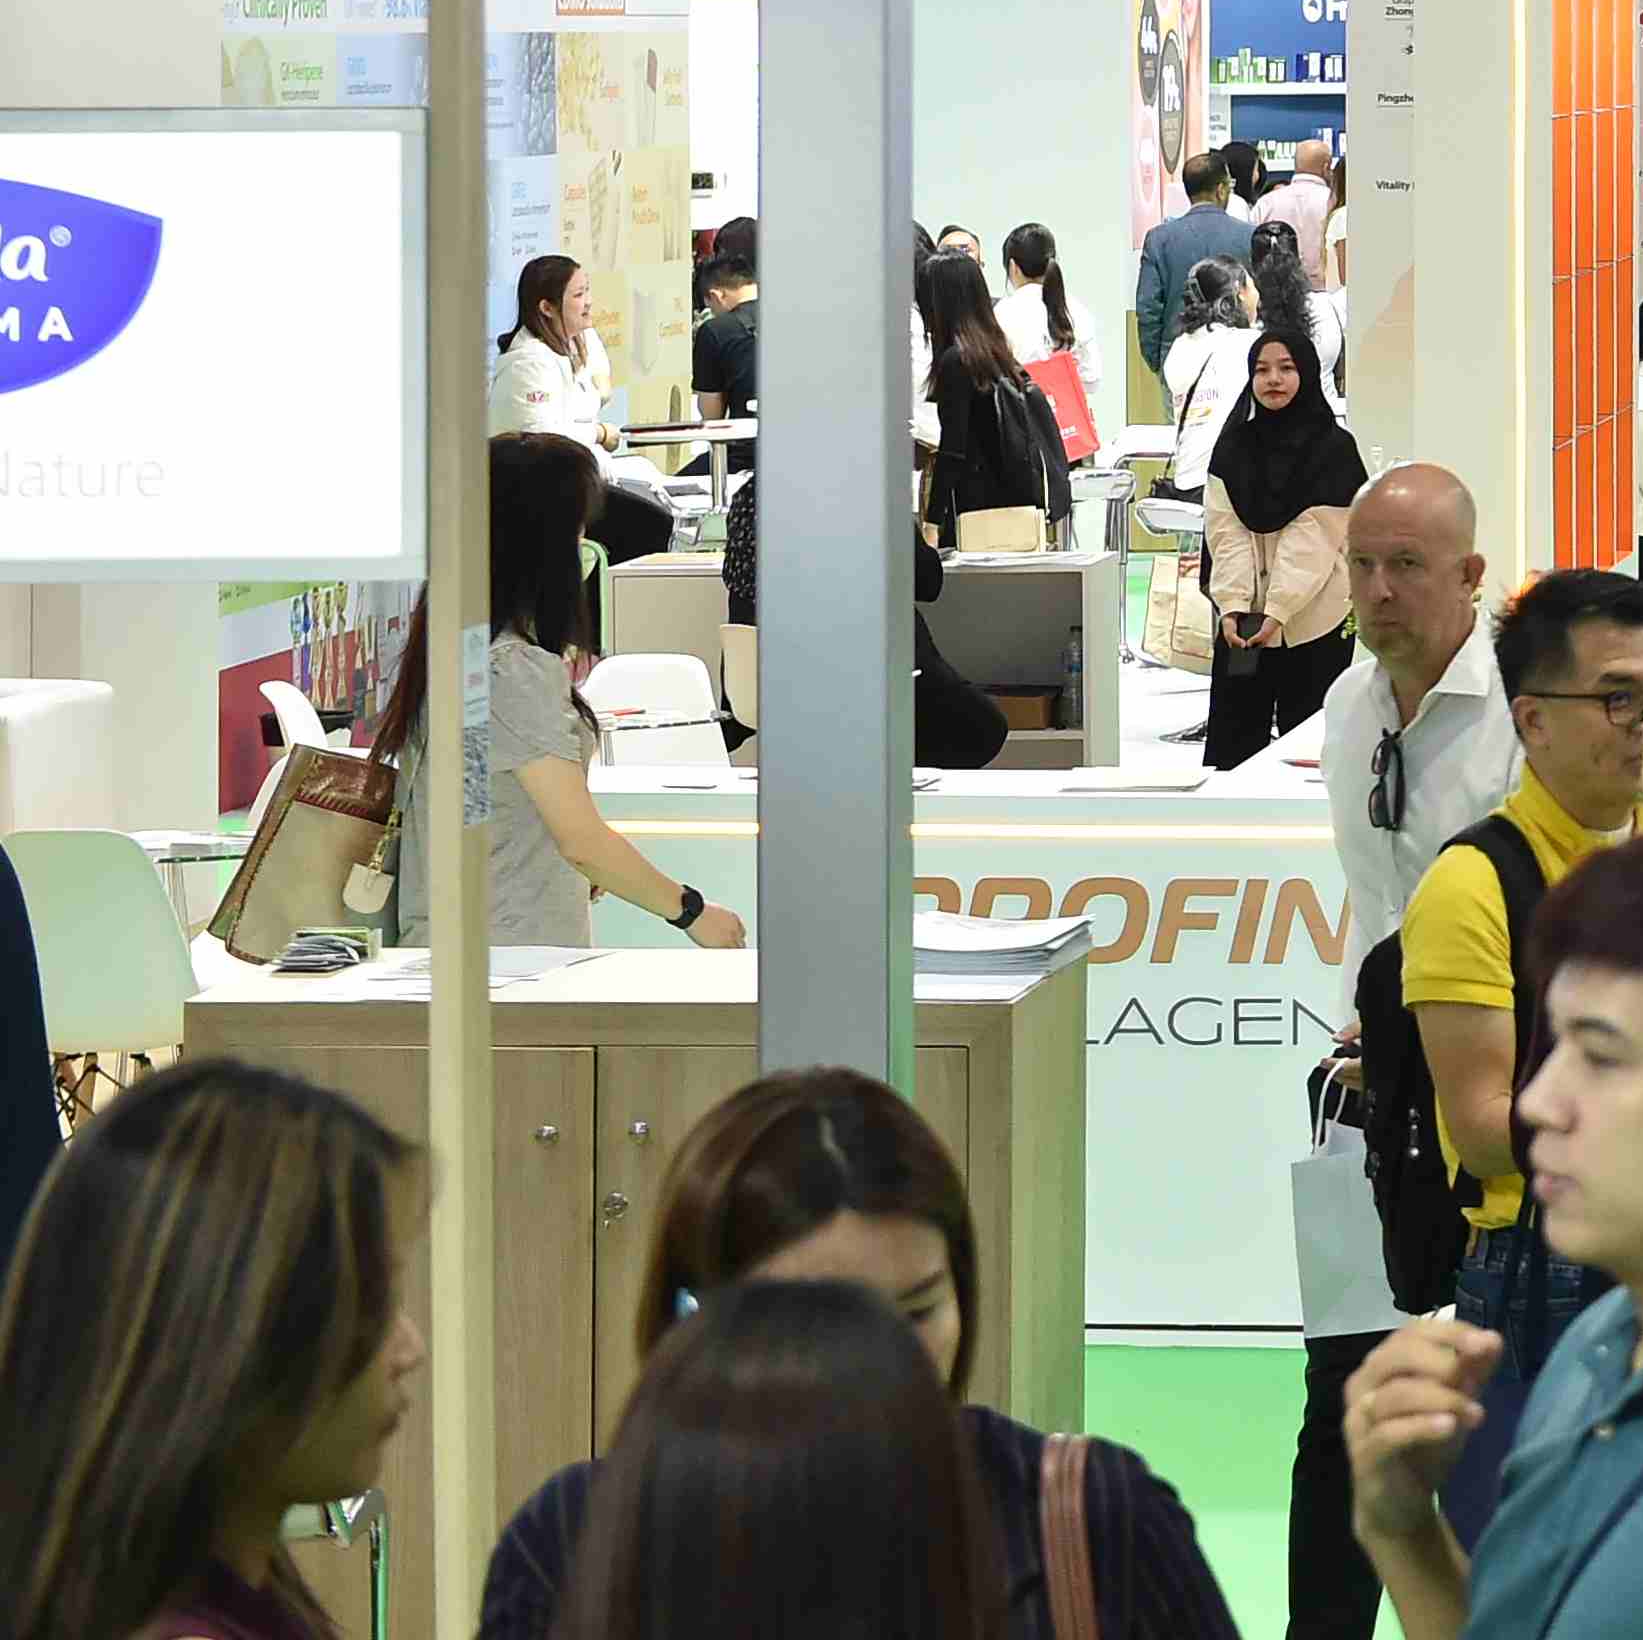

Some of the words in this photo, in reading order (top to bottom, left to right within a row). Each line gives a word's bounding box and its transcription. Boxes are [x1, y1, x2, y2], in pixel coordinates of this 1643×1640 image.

[1375, 180, 1410, 192] Vitality
[0, 446, 166, 498] ature
[913, 876, 1351, 966] OFIN
[1085, 996, 1338, 1046] AGEN
